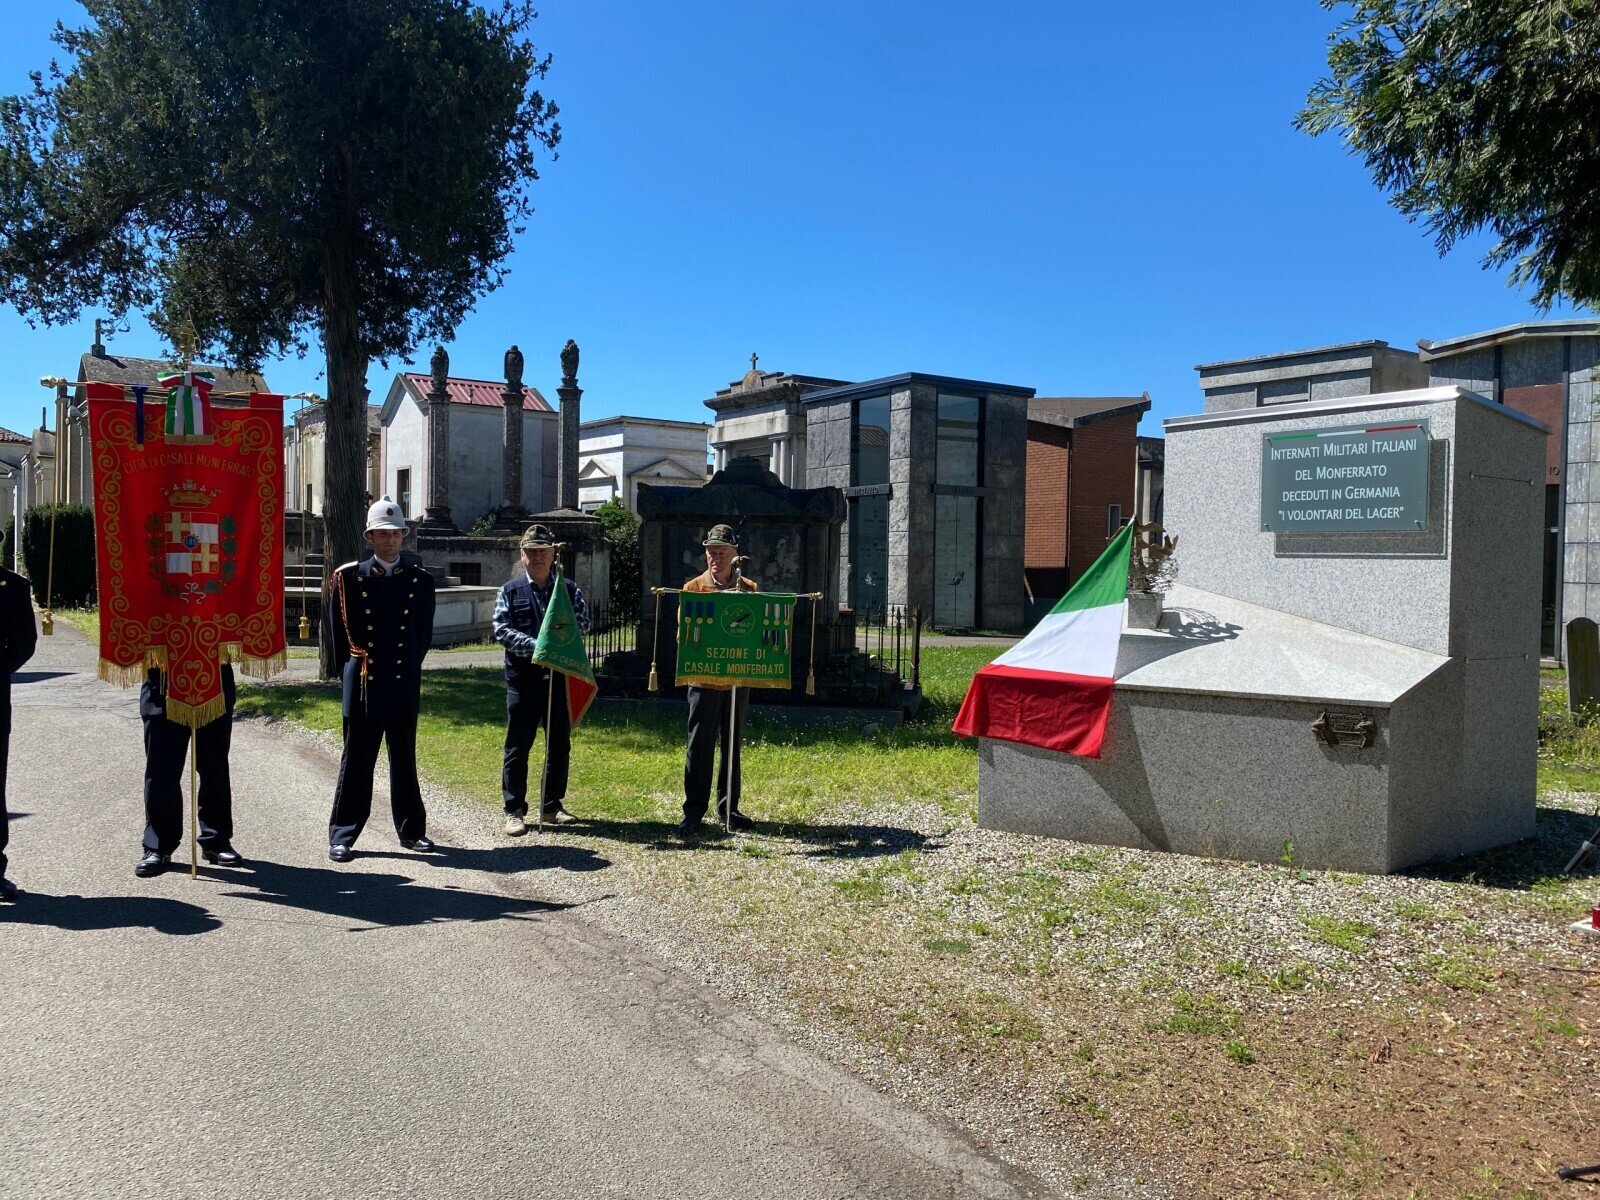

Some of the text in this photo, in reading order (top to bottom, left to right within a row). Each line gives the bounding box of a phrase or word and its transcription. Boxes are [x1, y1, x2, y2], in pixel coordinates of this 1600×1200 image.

[1271, 439, 1417, 460] INTERNATI MILITARI ITALIANI
[159, 452, 194, 466] CASALE
[196, 453, 256, 478] MONFERRATO
[1295, 465, 1387, 481] DEL MONFERRATO
[1282, 486, 1401, 502] DECEDUTI IN GERMANIA
[1288, 509, 1342, 521] VOLONTARI
[1345, 508, 1364, 519] DEL
[1367, 507, 1404, 518] LAGER"
[706, 647, 766, 660] SEZIONE DI
[684, 661, 784, 675] CASALE MONFERRATO
